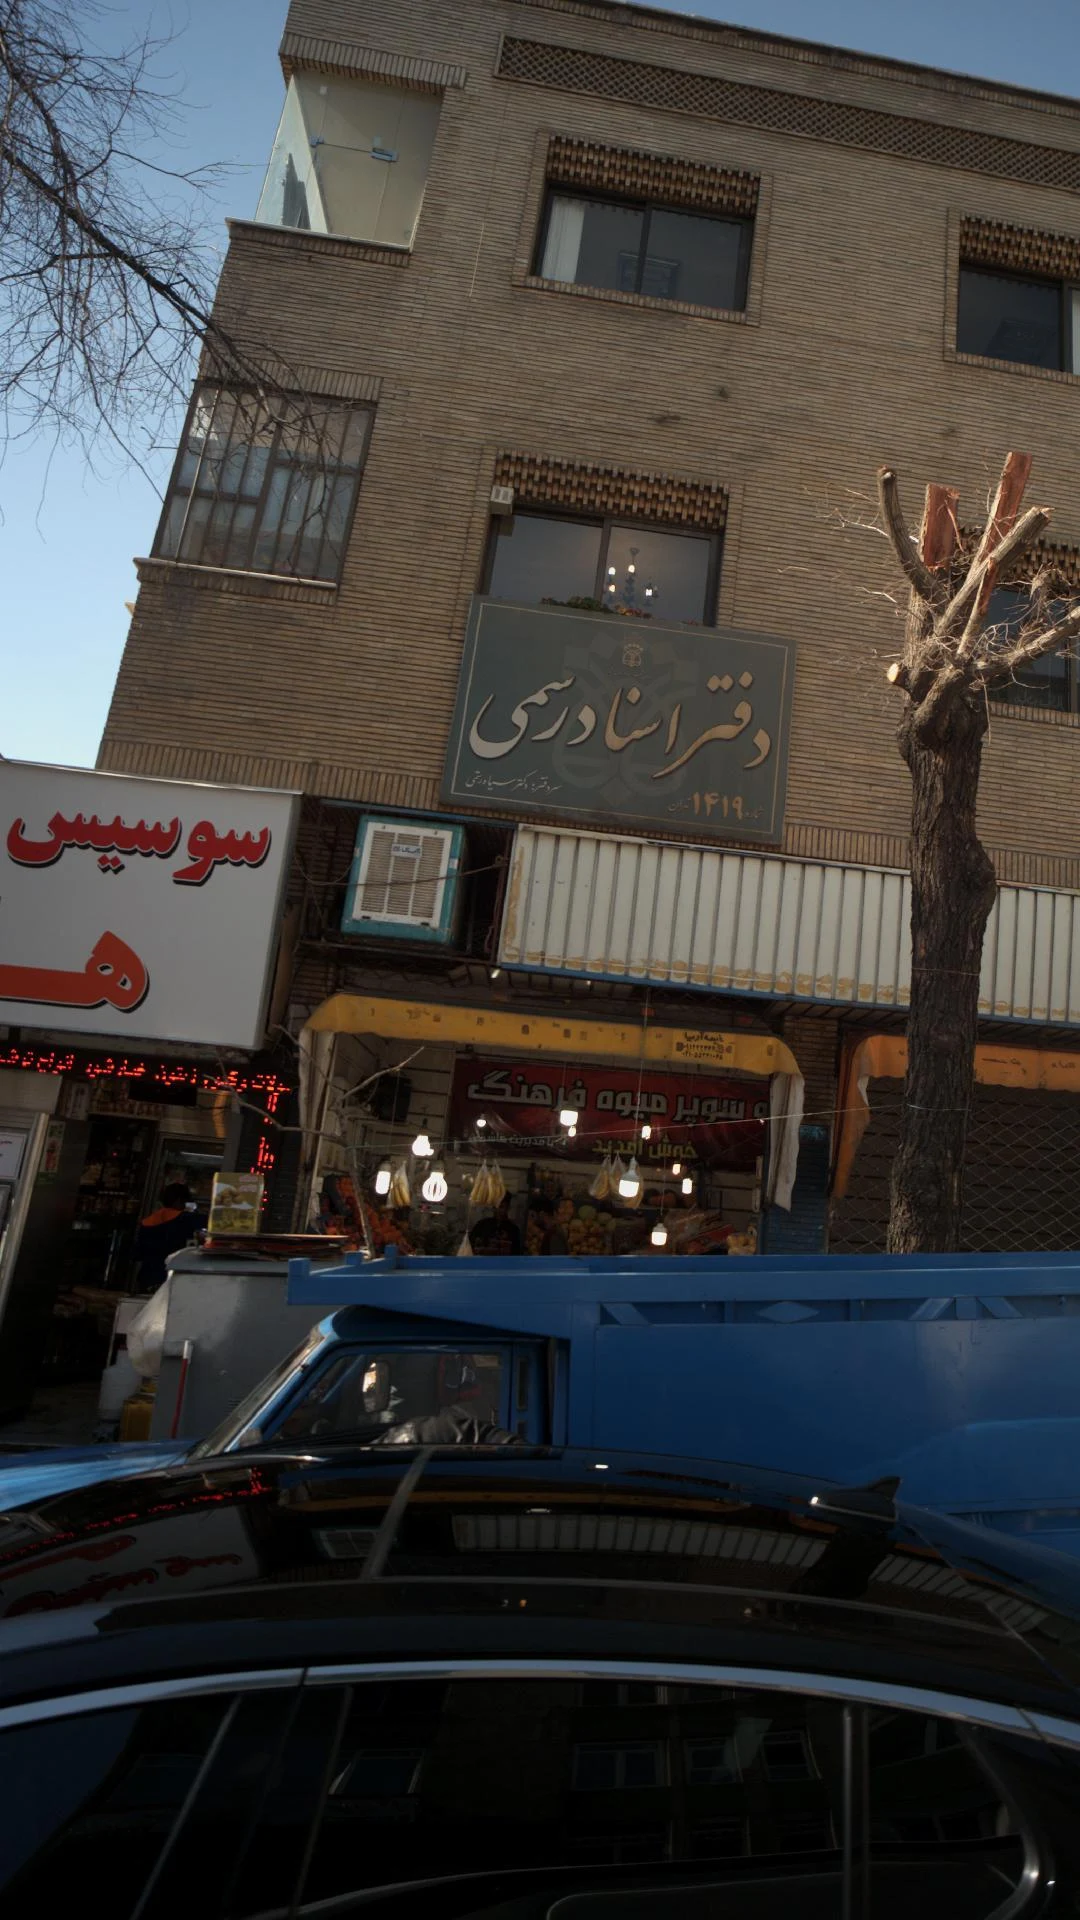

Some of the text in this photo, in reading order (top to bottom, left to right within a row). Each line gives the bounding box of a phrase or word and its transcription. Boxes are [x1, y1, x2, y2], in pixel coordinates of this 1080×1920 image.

[468, 671, 772, 779] دفتر اسناد رسمی
[691, 791, 744, 820] ۱۴۱۹
[7, 811, 270, 885] سوسیس
[595, 1087, 668, 1118] میوه
[672, 1092, 748, 1126] سوپر
[650, 1132, 699, 1160] خوش
